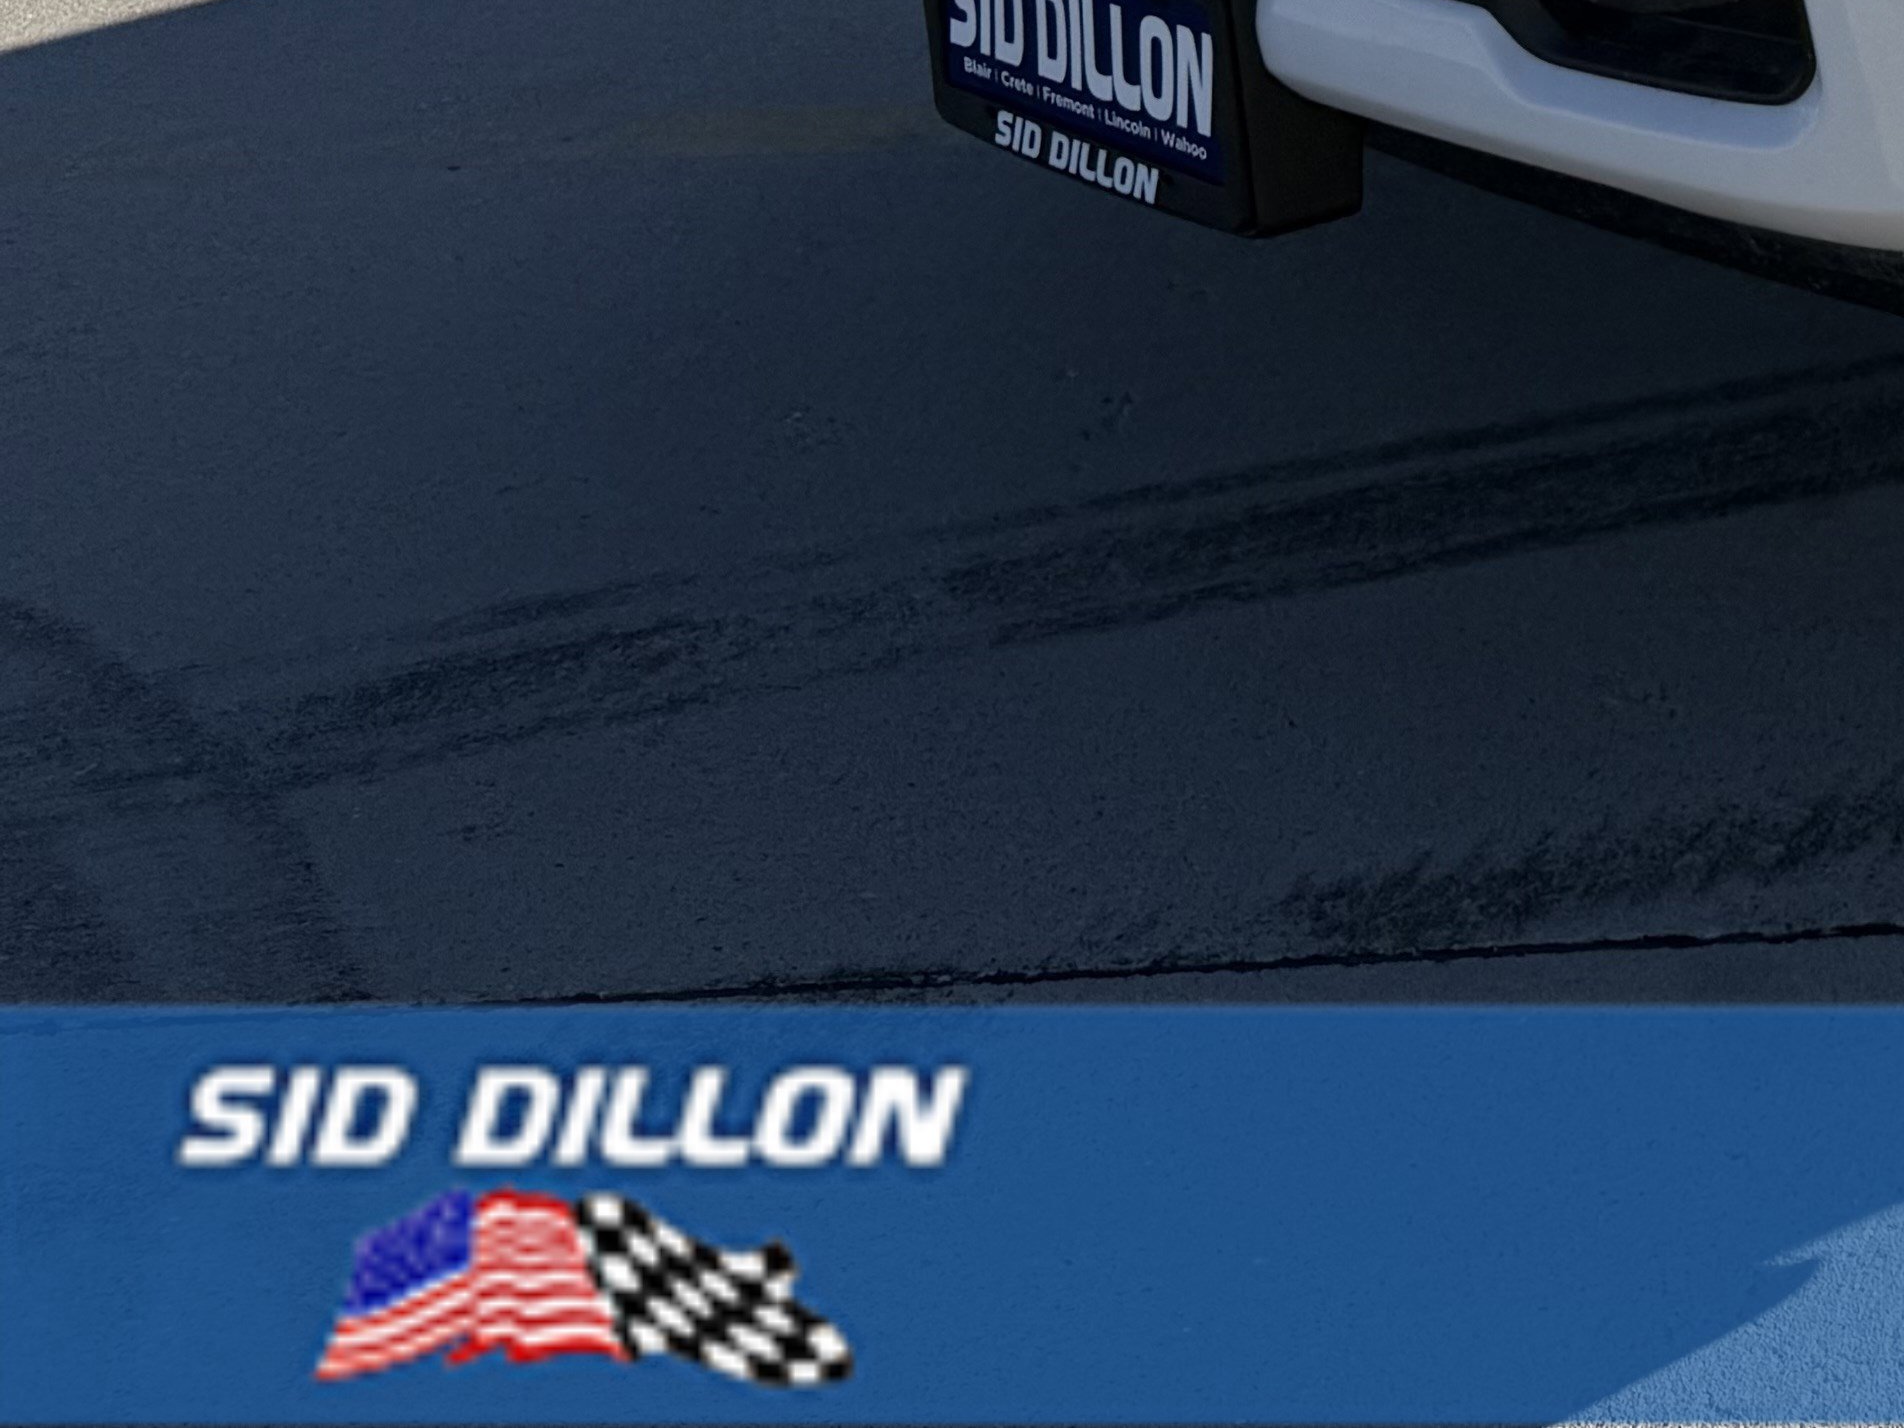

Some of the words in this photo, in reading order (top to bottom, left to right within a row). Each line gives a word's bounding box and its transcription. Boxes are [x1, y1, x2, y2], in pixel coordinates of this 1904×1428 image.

[963, 56, 993, 82] Blair
[1000, 70, 1034, 97] Crete
[1042, 89, 1095, 120] Fremont
[1104, 109, 1151, 139] Lincoln
[1160, 128, 1208, 160] Wahoo
[994, 109, 1041, 160] SID
[1048, 130, 1159, 204] DILLON
